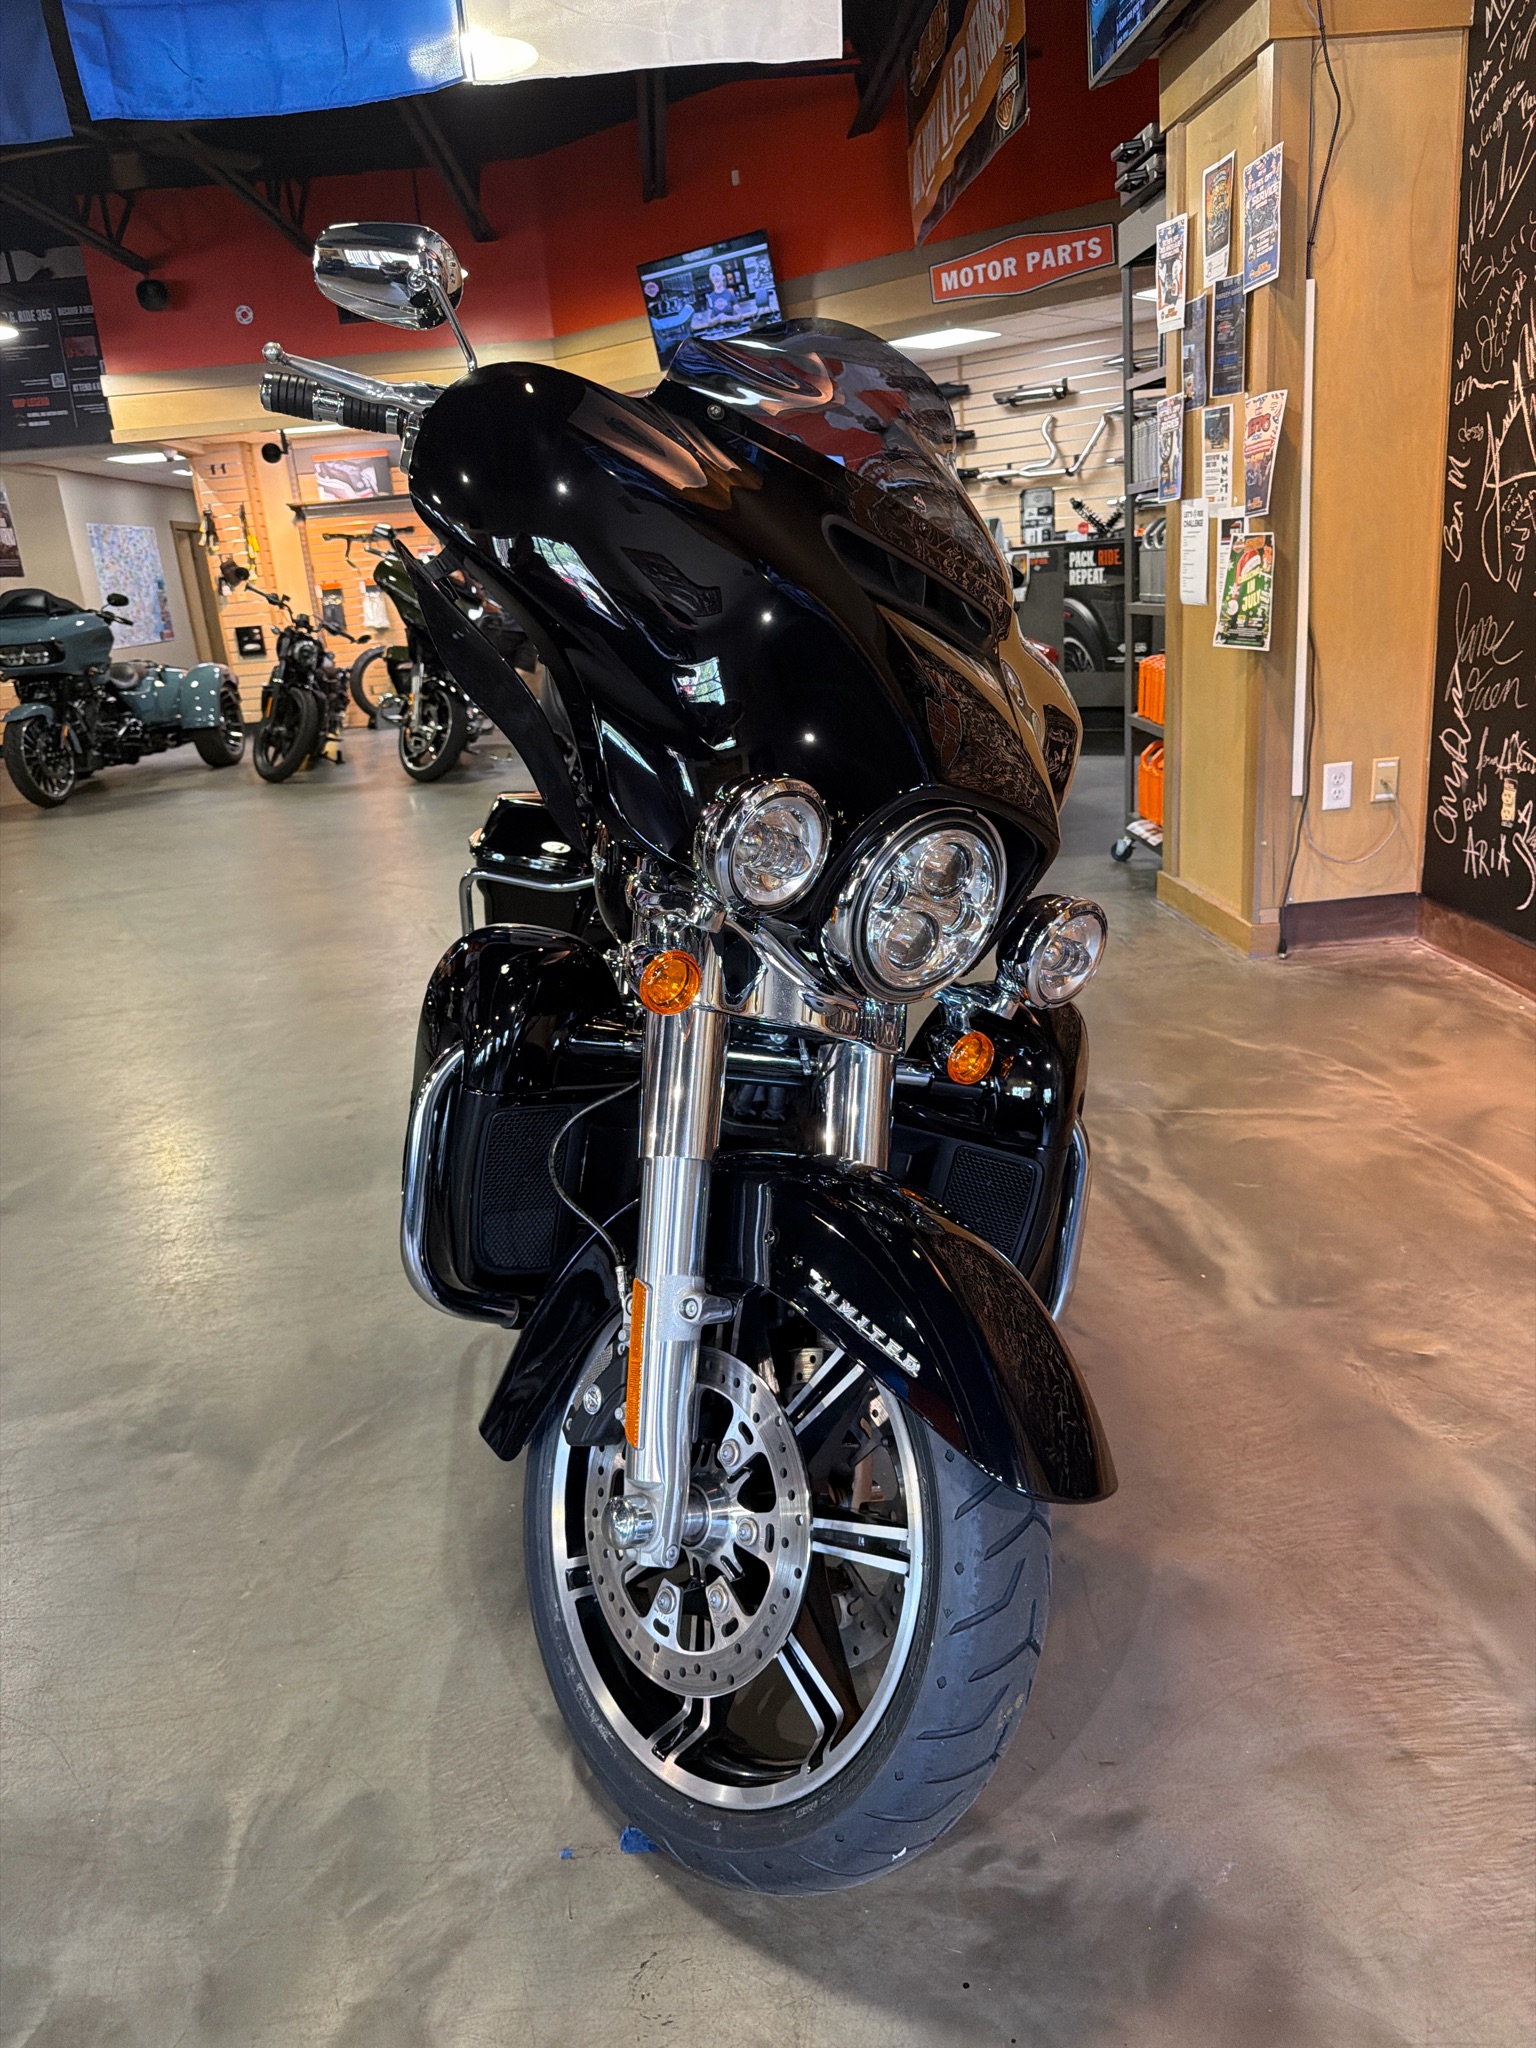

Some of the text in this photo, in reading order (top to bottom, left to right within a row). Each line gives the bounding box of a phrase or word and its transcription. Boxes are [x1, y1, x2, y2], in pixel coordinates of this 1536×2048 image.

[940, 237, 1103, 292] MOTOR PARTS
[36, 308, 52, 321] 365
[1068, 549, 1097, 568] PACK.
[1097, 548, 1123, 566] RIDE.
[1068, 567, 1107, 586] REPEAT.
[1241, 589, 1262, 612] JULY
[808, 1276, 922, 1377] LIMITED
